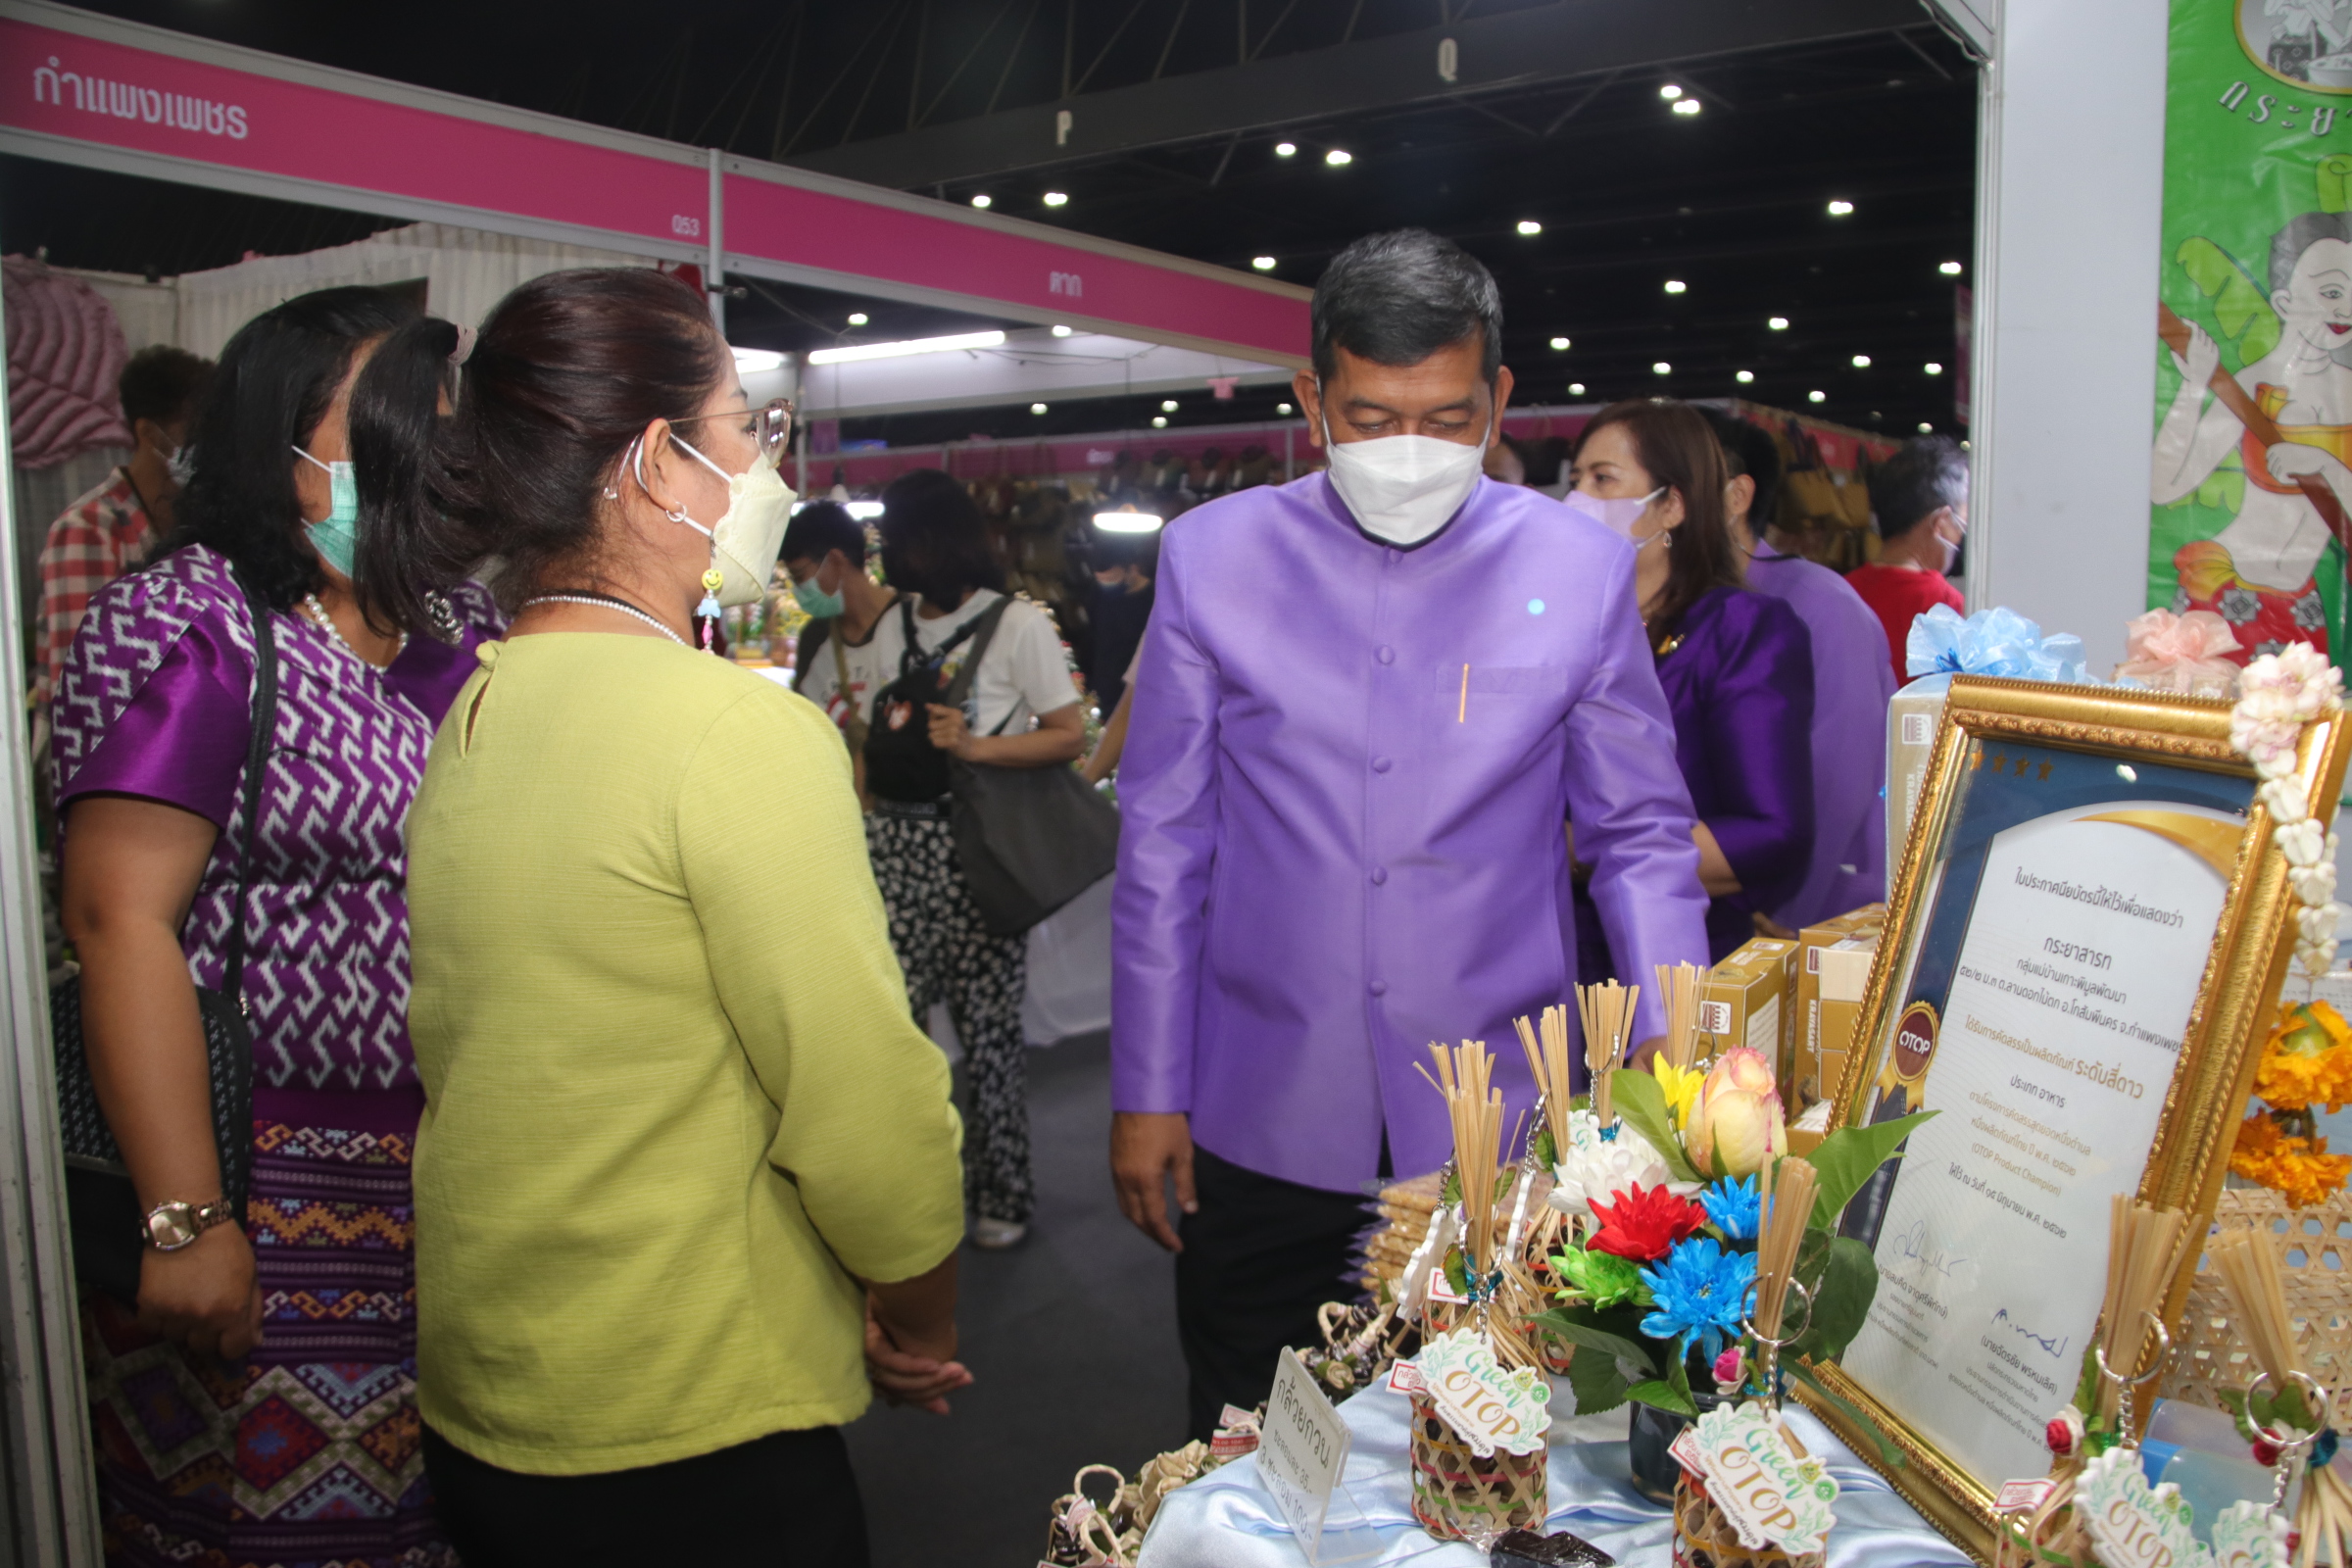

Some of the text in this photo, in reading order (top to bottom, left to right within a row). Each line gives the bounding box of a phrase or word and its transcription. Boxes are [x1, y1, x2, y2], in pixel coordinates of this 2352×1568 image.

[1438, 37, 1458, 81] Q
[33, 57, 248, 140] กำแพงเพชร
[2217, 80, 2352, 137] กระย
[1056, 110, 1072, 145] P
[671, 215, 700, 237] Q53
[1050, 271, 1082, 298] ตาก
[2014, 866, 2184, 928] ใบประกาศนียบัตรนี้ให้ไว้เพื่อแสดงว่า
[2043, 937, 2112, 970] กระยาสารท
[1898, 1031, 1931, 1054] OTOP
[1965, 1014, 2144, 1100] ได้รับการคัดสรรเป็นผลิตภัณฑ์ ระดับสี่ดาว
[2010, 1074, 2066, 1108] ประเภท อาหาร
[1969, 1091, 2091, 1156] ตามโครงการคัดสรรสุดยอดหนึ่งตำบล
[1971, 1115, 2029, 1152] หนึ่งผลิตภัณฑ์ไทย
[1972, 1142, 2062, 1197] (OTOP Product Champion)
[1445, 1370, 1520, 1436] OTOP
[1465, 1350, 1525, 1408] Green
[1276, 1376, 1331, 1469] กล้วยกวน
[1260, 1446, 1267, 1465] 3
[1744, 1428, 1808, 1499] Green
[1720, 1446, 1796, 1531] OTOP
[2122, 1472, 2175, 1537] Green
[2109, 1499, 2174, 1568] OTOP
